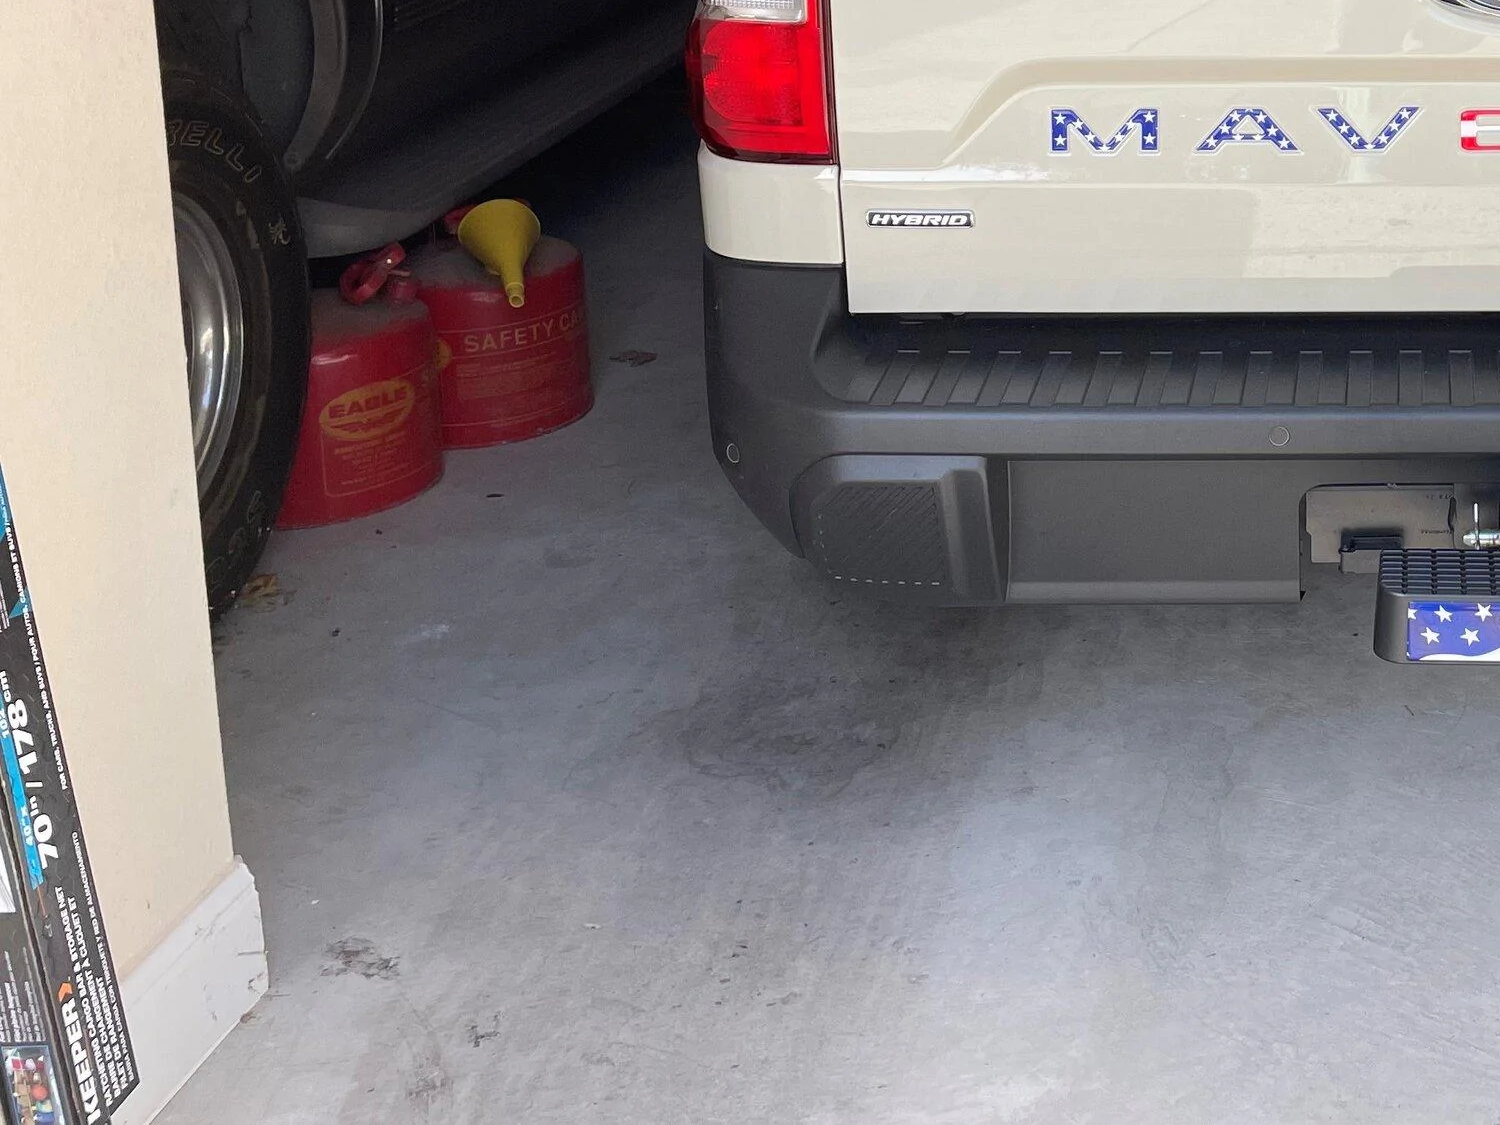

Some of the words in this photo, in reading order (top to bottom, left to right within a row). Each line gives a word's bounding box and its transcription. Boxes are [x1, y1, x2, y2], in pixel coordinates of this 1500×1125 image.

[870, 211, 972, 227] HYBRID
[464, 322, 556, 353] SAFETY
[328, 386, 408, 419] EAGLE
[10, 550, 18, 562] ET
[12, 563, 26, 604] CAMIONS
[23, 603, 34, 636] AUTOS,
[29, 637, 39, 661] POUR
[41, 691, 50, 709] AND
[45, 710, 59, 747] TRUCKS,
[54, 746, 64, 773] CARS,
[59, 773, 68, 790] FOR
[71, 831, 94, 907] ALMACENAMIENTO
[55, 885, 67, 909] NET
[67, 895, 78, 911] ET
[88, 906, 97, 918] DE
[91, 918, 101, 935] RED
[60, 910, 79, 962] STORAGE
[72, 912, 88, 958] CLIQUET
[97, 942, 113, 985] TRINQUETE
[75, 975, 88, 998] BAR
[107, 984, 118, 1003] CON
[81, 998, 97, 1039] CARGO
[86, 969, 111, 1044] CHARGEMENT
[95, 975, 119, 1043] RANGEMENT
[113, 1003, 125, 1032] CARGA
[103, 1044, 115, 1060] DE
[110, 1043, 122, 1059] DE
[120, 1032, 130, 1054] PARA
[61, 997, 101, 1125] KEEPER
[90, 1039, 114, 1107] RATCHETING
[115, 1060, 129, 1090] FILET
[124, 1054, 135, 1081] BARRA
[106, 1061, 121, 1098] BARRE
